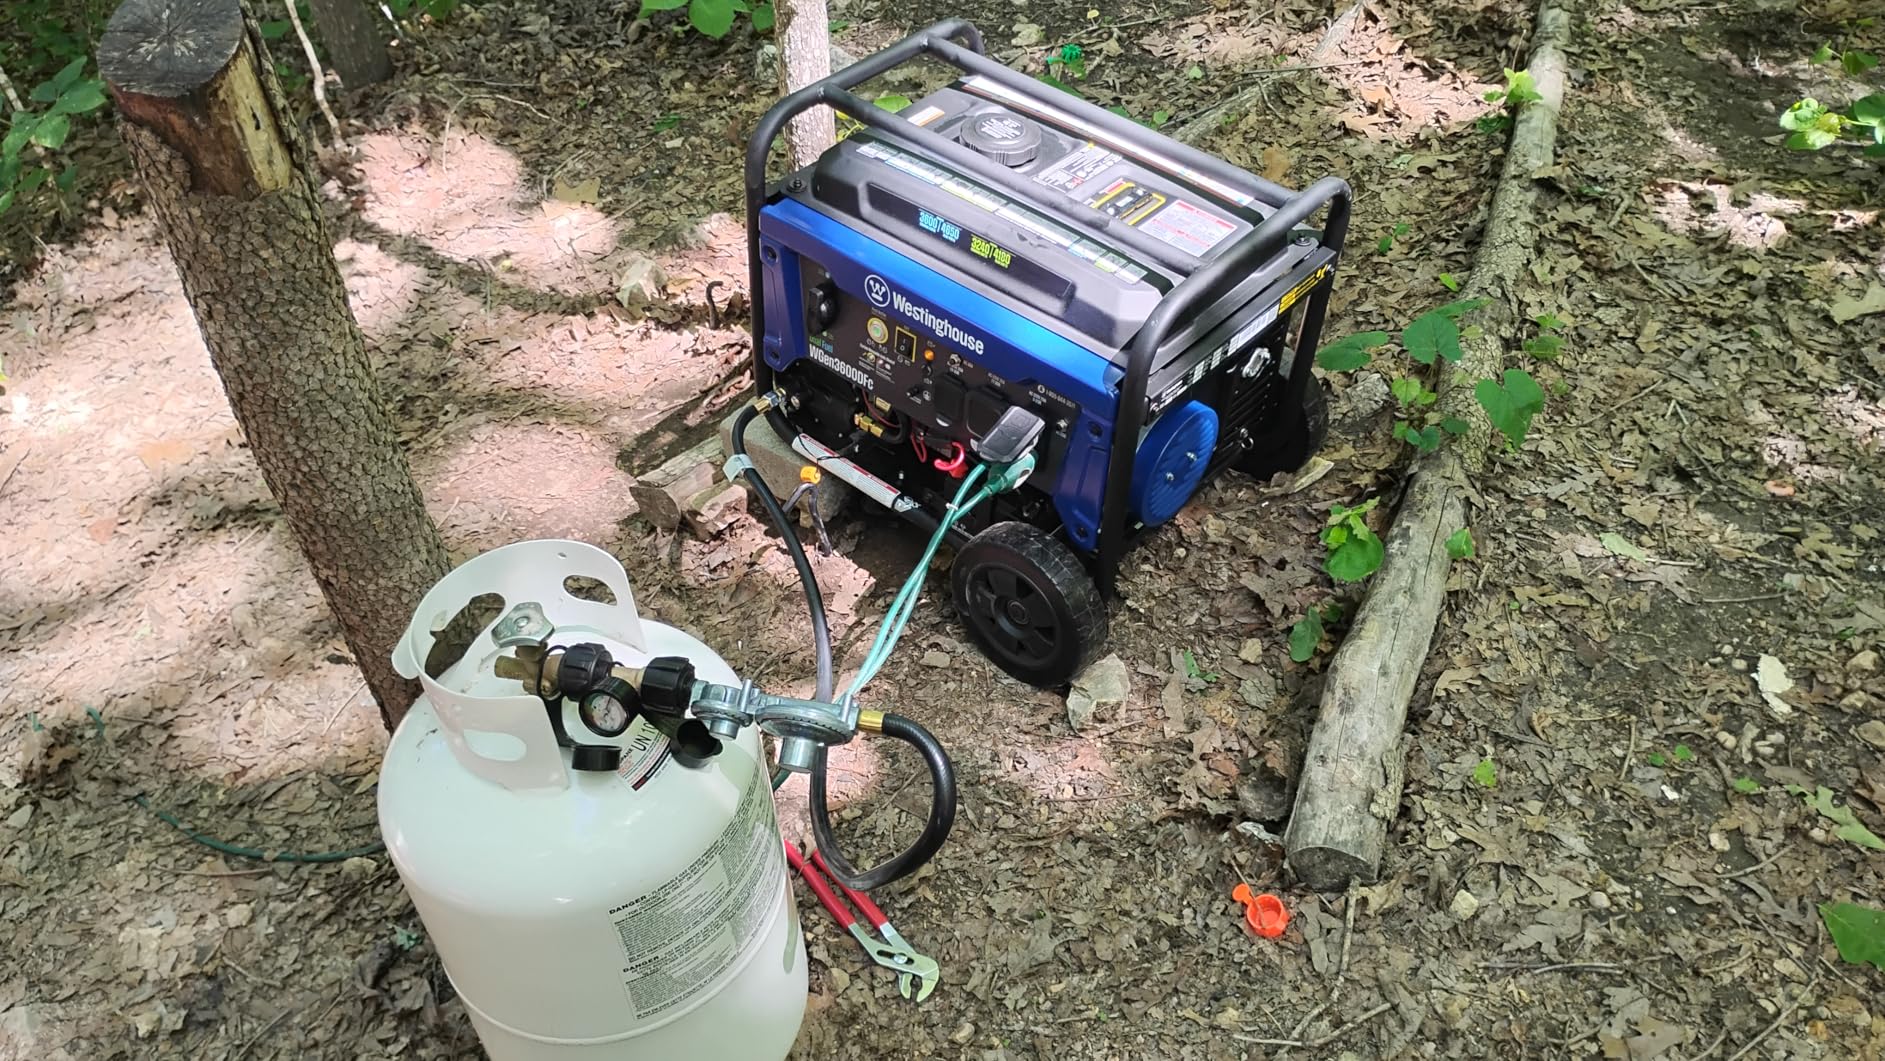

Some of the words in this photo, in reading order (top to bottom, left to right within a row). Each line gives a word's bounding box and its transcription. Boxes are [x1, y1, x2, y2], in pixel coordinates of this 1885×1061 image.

[971, 237, 990, 254] 3240
[993, 248, 1011, 264] 4180
[892, 291, 984, 355] Westinghouse
[809, 343, 874, 390] WGen3600DFc
[631, 734, 652, 751] UN
[609, 896, 646, 914] DANGER
[623, 955, 659, 973] DANGER
